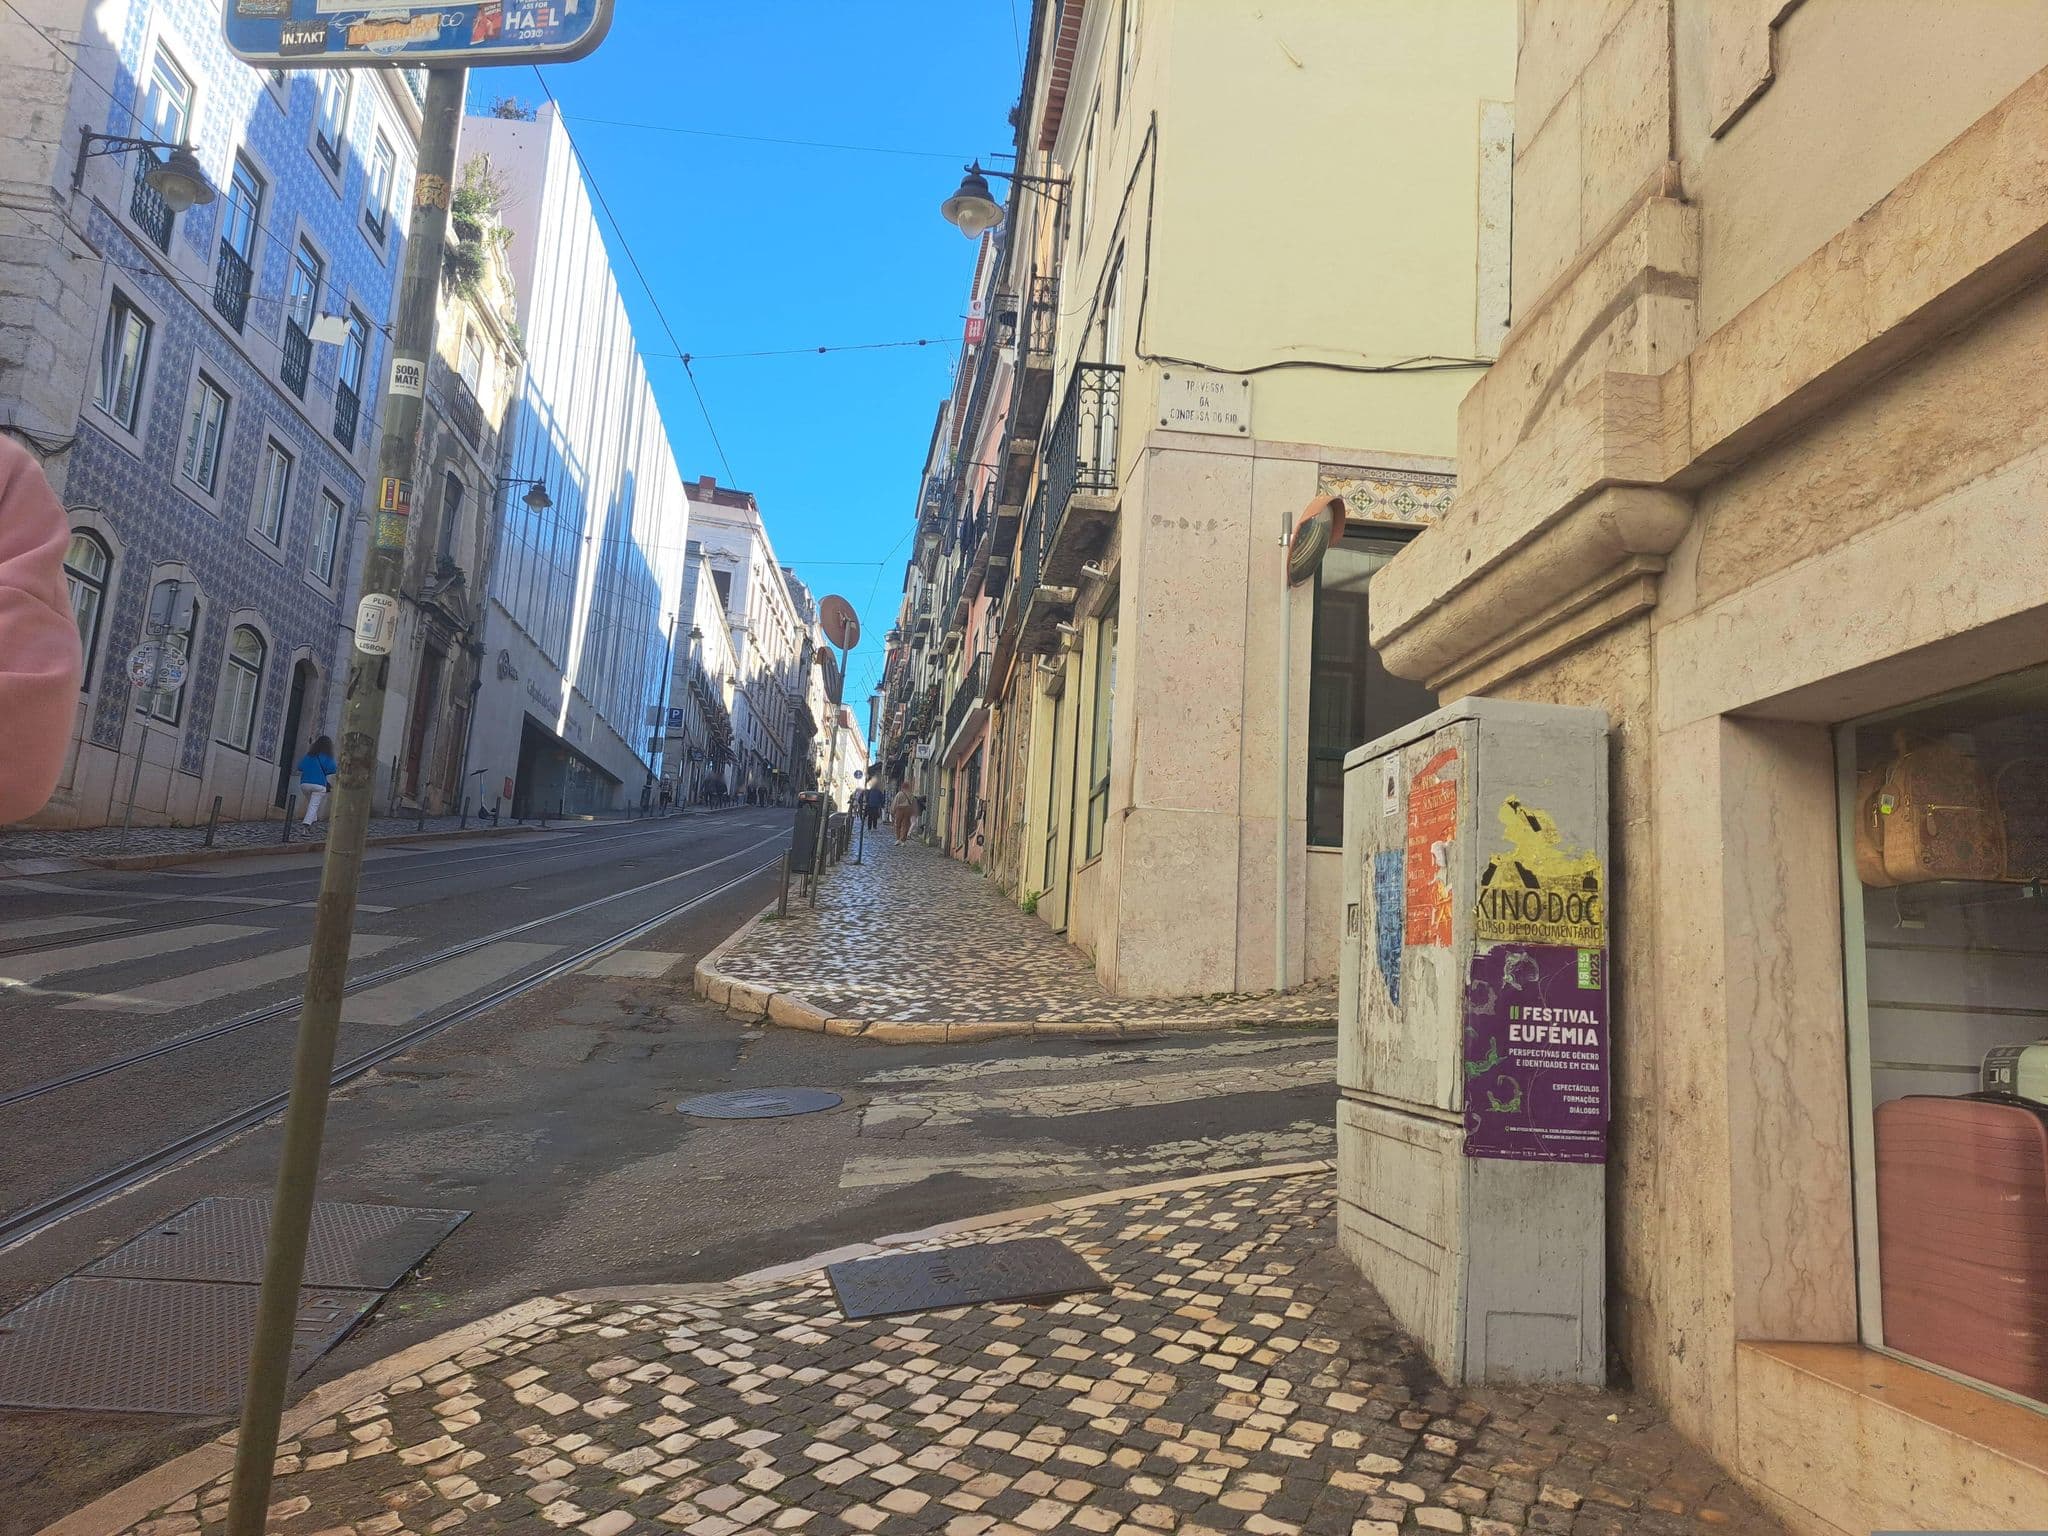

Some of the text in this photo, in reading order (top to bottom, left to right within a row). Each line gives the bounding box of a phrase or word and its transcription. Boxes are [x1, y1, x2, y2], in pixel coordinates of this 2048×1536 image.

[505, 8, 560, 30] HAEL
[395, 364, 419, 377] SODA
[394, 375, 419, 387] MATE
[1185, 380, 1225, 394] TRVESSA
[373, 597, 393, 608] PLUG
[359, 642, 386, 653] LISBON
[672, 709, 681, 719] P
[1508, 922, 1521, 936] DE
[1590, 953, 1600, 986] 2023
[1523, 1006, 1599, 1025] FESTIVAL
[1509, 1022, 1599, 1046] EUFÉMIA
[1509, 1048, 1560, 1059] PERSPECTIVAS
[1561, 1051, 1570, 1059] DE
[1516, 1059, 1600, 1071] E IDENTIDADES EM CENA
[1552, 1083, 1600, 1093] ESPECTÁCULOS
[1563, 1094, 1600, 1105] FORMAÇÕES
[1569, 1106, 1600, 1115] DIÁLOGOS
